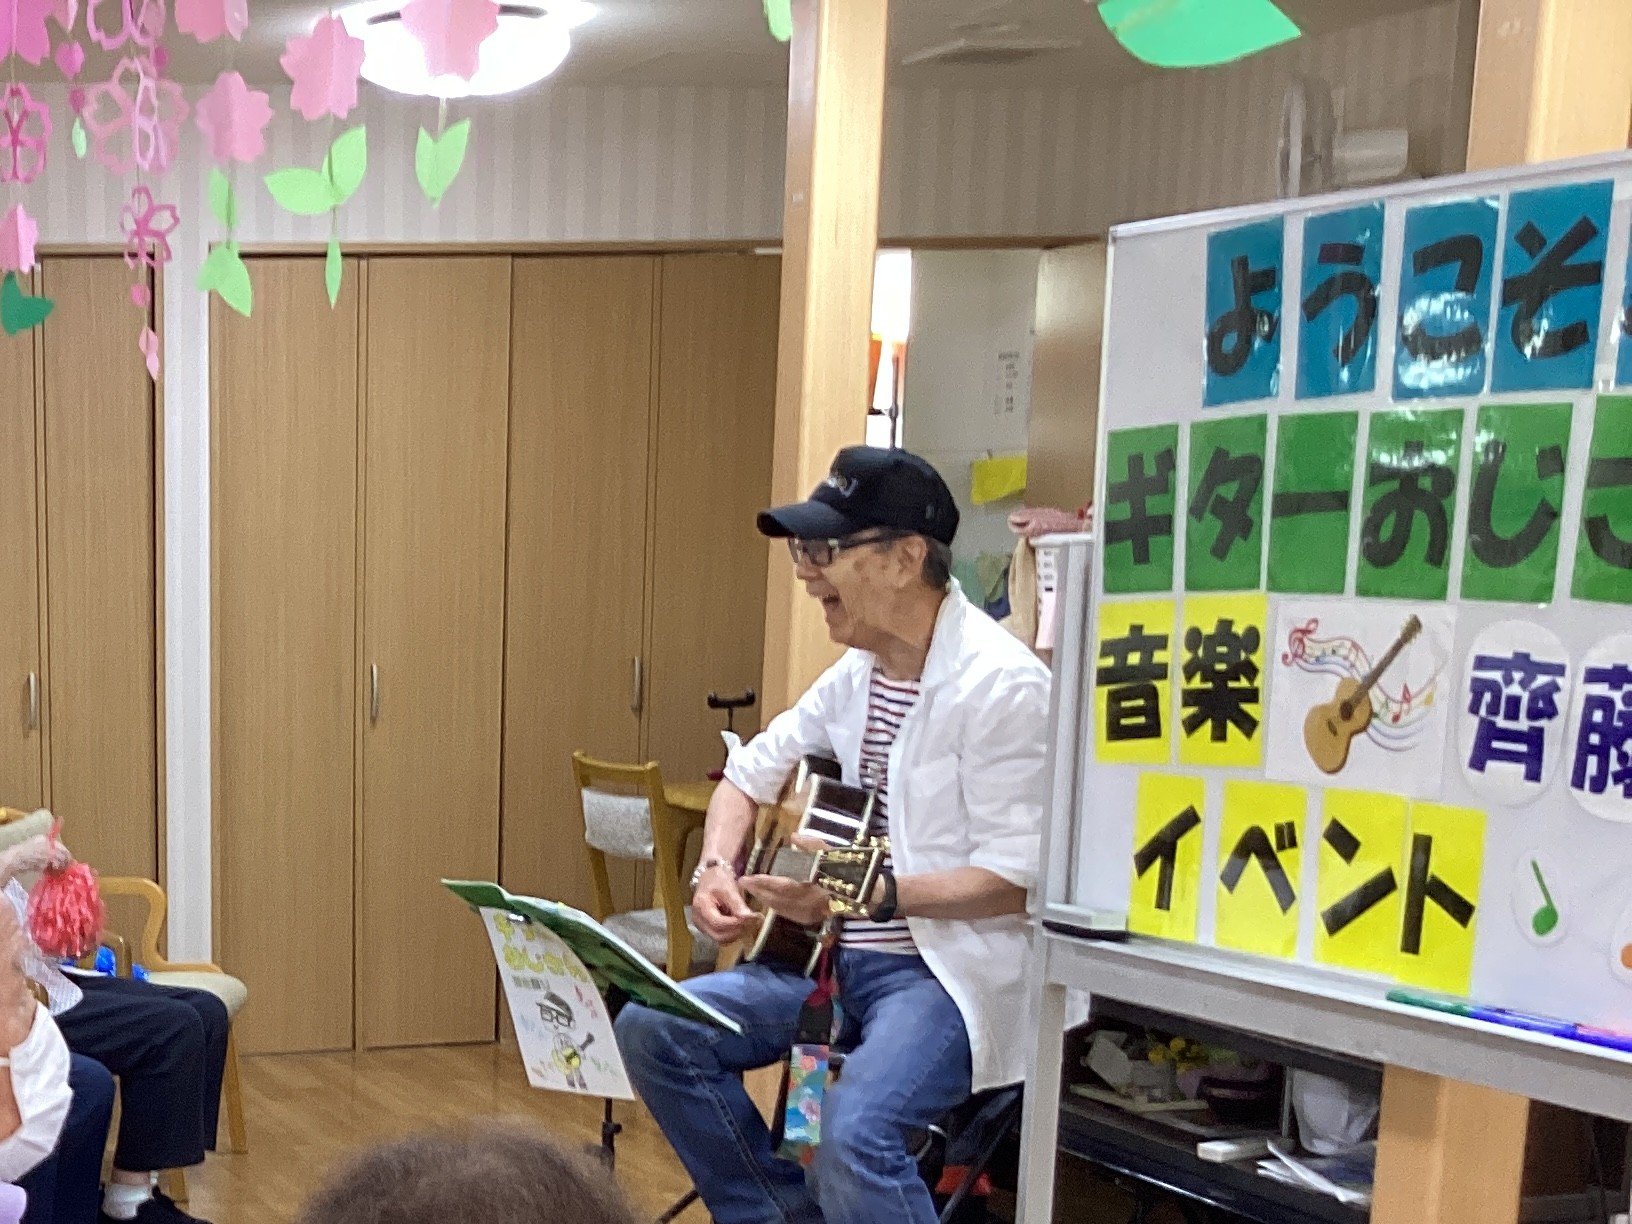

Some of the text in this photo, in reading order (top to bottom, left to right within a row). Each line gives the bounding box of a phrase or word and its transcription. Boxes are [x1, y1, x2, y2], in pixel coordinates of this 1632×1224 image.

[1206, 215, 1602, 377] ようこそ
[1095, 618, 1261, 742] 音楽
[1132, 804, 1476, 955] イベント
